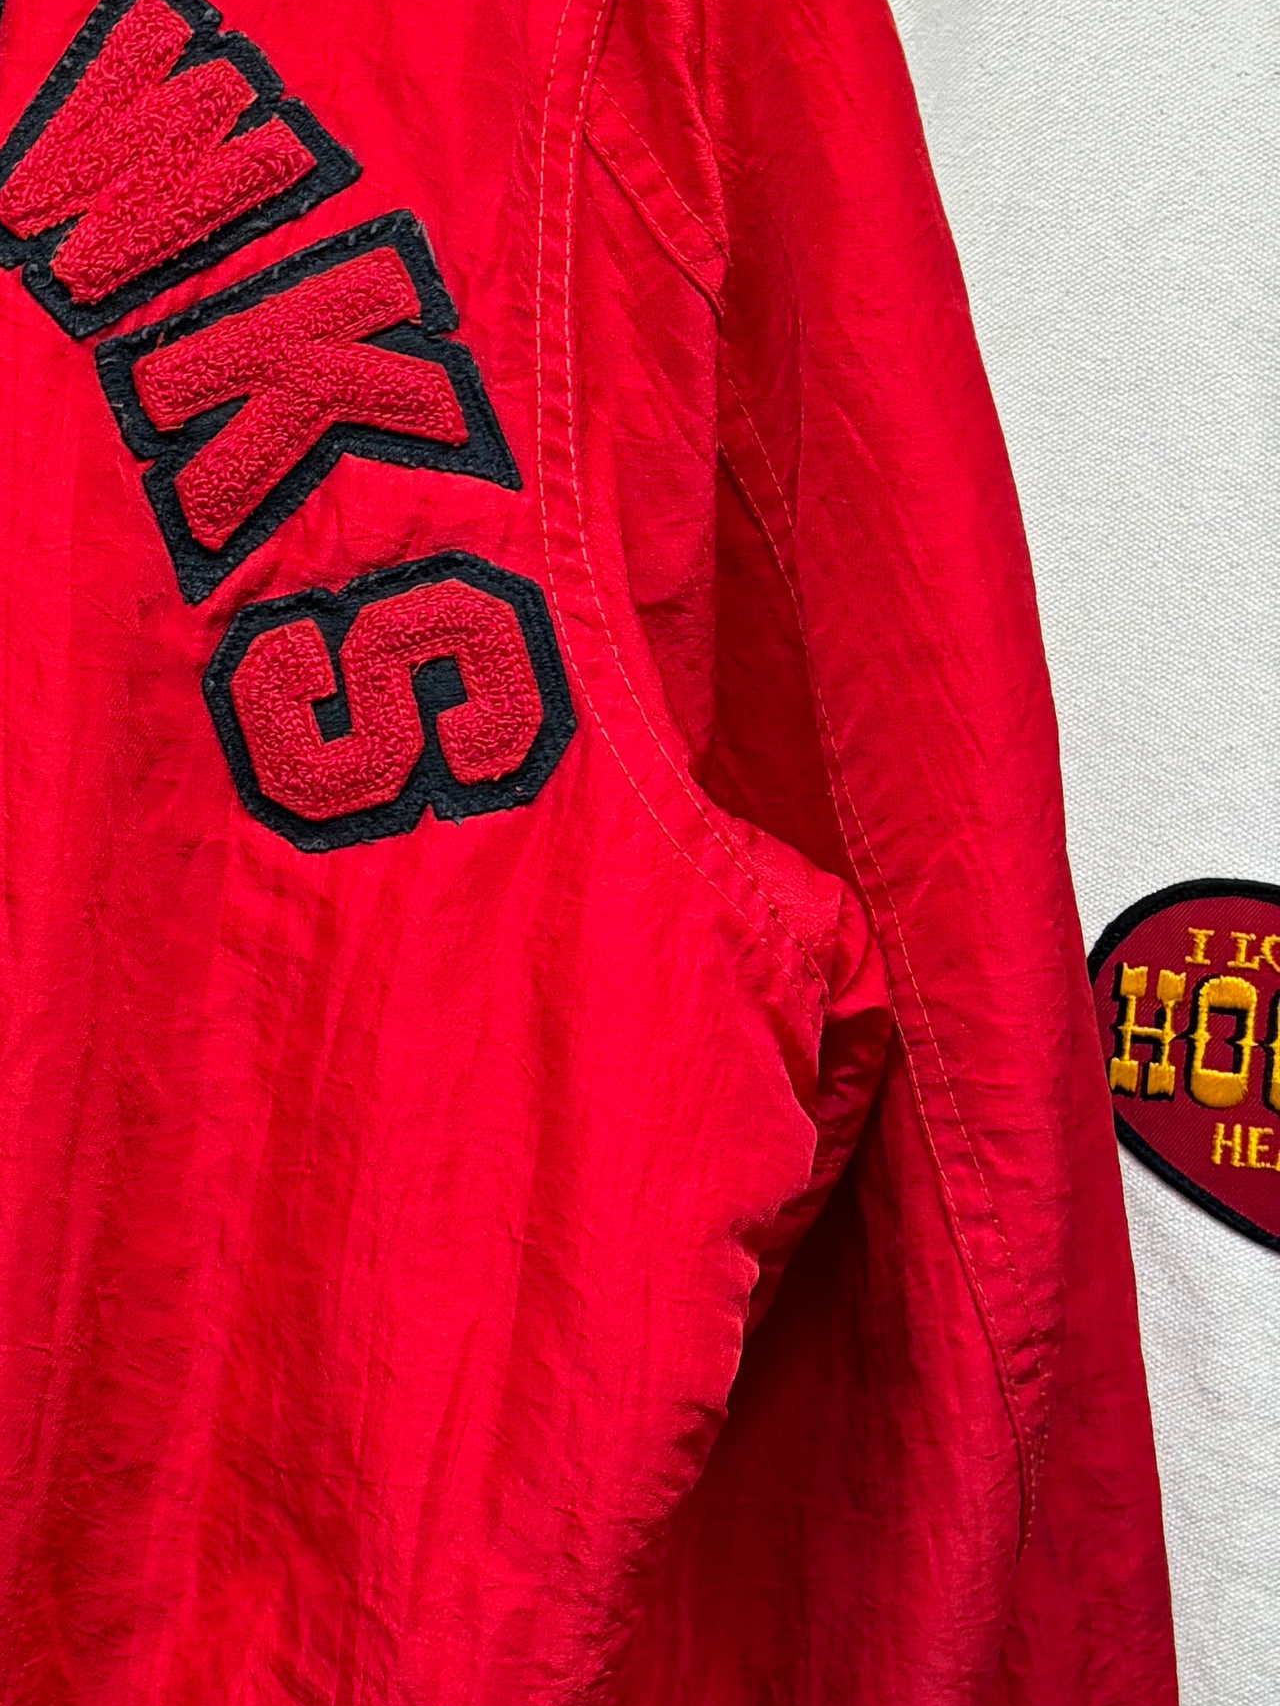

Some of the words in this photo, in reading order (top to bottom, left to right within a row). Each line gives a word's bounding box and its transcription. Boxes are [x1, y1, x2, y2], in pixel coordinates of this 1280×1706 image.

[1184, 927, 1215, 965] I
[1108, 962, 1280, 1109] HO
[1211, 1122, 1280, 1173] HE
